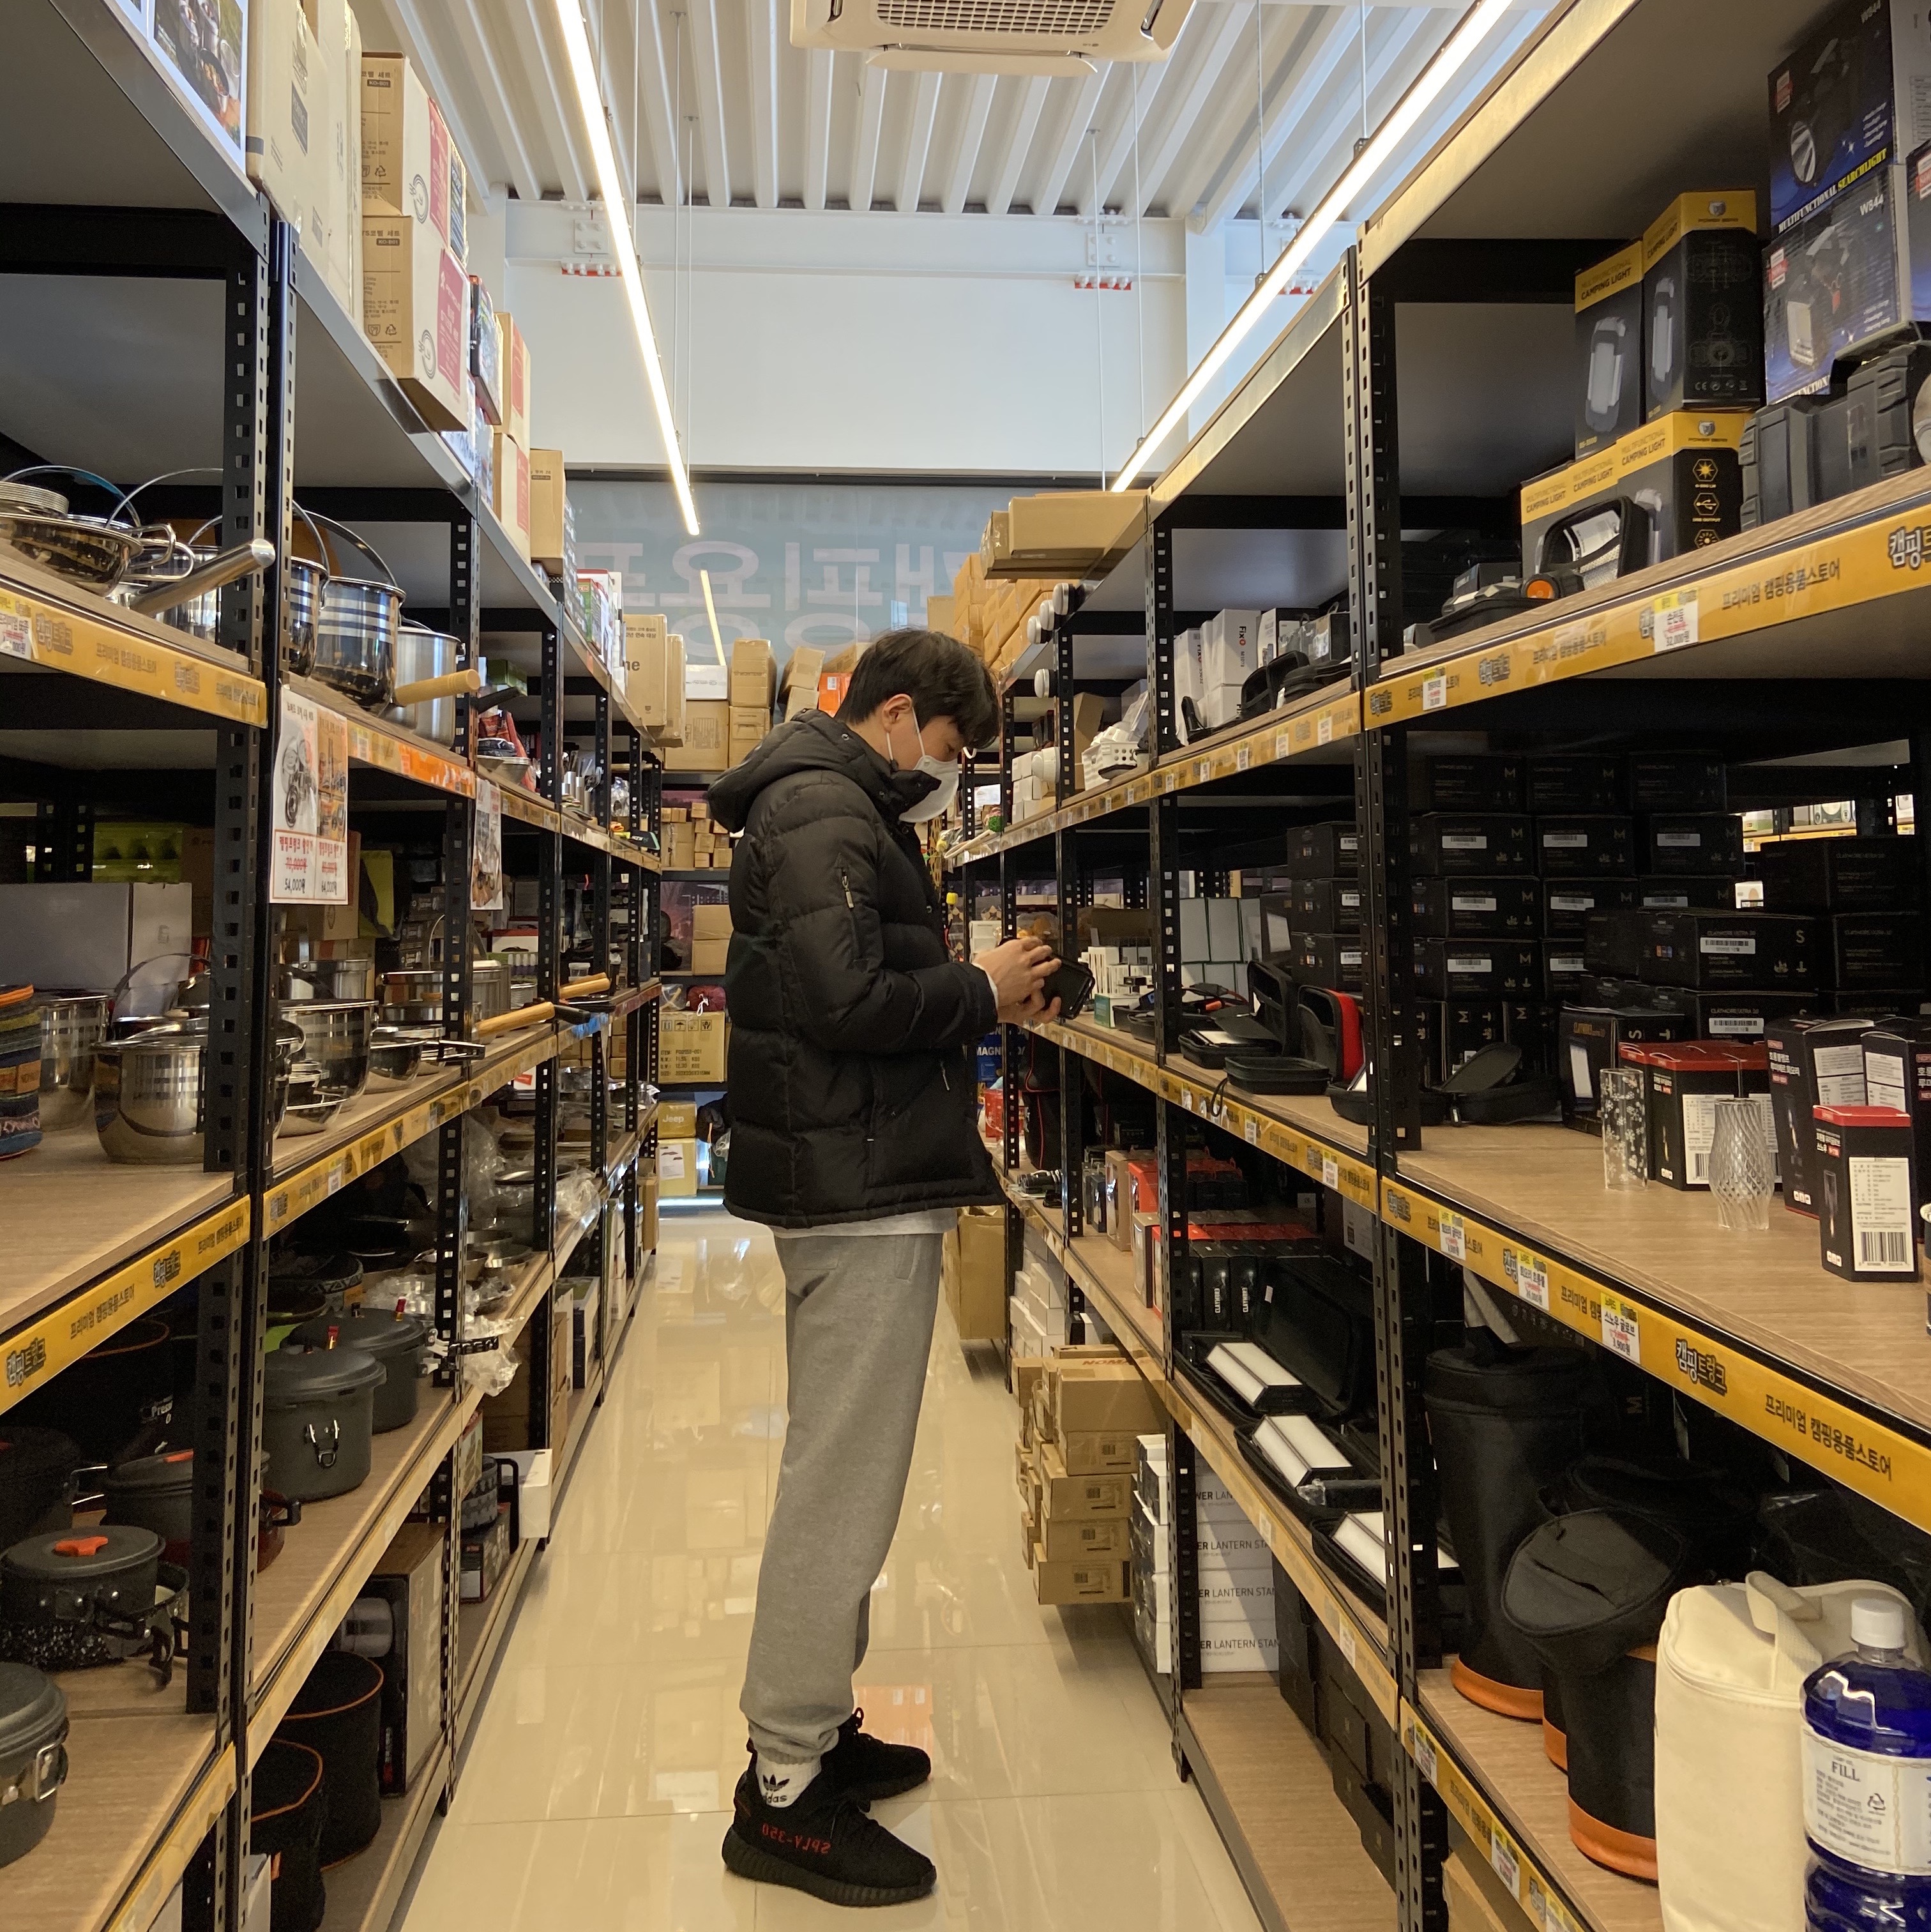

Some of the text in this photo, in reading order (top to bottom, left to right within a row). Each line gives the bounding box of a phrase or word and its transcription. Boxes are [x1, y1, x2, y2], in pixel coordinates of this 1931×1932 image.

[1778, 148, 1887, 234] MULTIFUNCTIONAL SEARCHLIGHT
[1859, 194, 1884, 216] W844
[1580, 267, 1632, 300] CAMPING LIGHT
[1621, 439, 1666, 466] CAMPING LIGHT
[1573, 468, 1613, 492] CAMPING LIGHT
[1526, 491, 1566, 513] CAMPING LIGHT
[1722, 558, 1840, 611] 프리미엄 캠핑용품스토어
[1504, 767, 1516, 778] M
[1511, 828, 1523, 839] M
[1522, 891, 1533, 902] M
[1796, 929, 1805, 944] S
[1519, 953, 1531, 964] M
[662, 1114, 685, 1124] Jeep
[153, 1250, 181, 1289] 캠핑트렁크
[71, 1283, 135, 1339] 프리미엄 캠핑용품스토어
[1561, 1285, 1588, 1315] 프리미엄
[1604, 1311, 1619, 1329] 스노우
[1619, 1318, 1636, 1337] 글로브
[6, 1337, 47, 1388] 캠핑트렁크
[1676, 1338, 1728, 1397] 캠핑트렁크
[1765, 1393, 1892, 1482] 프리미엄 캠핑용품스토어
[1211, 1540, 1252, 1550] LANTERN
[1212, 1588, 1253, 1597] LANTERN
[1214, 1639, 1255, 1649] LANTERN
[1831, 1761, 1861, 1783] FILL
